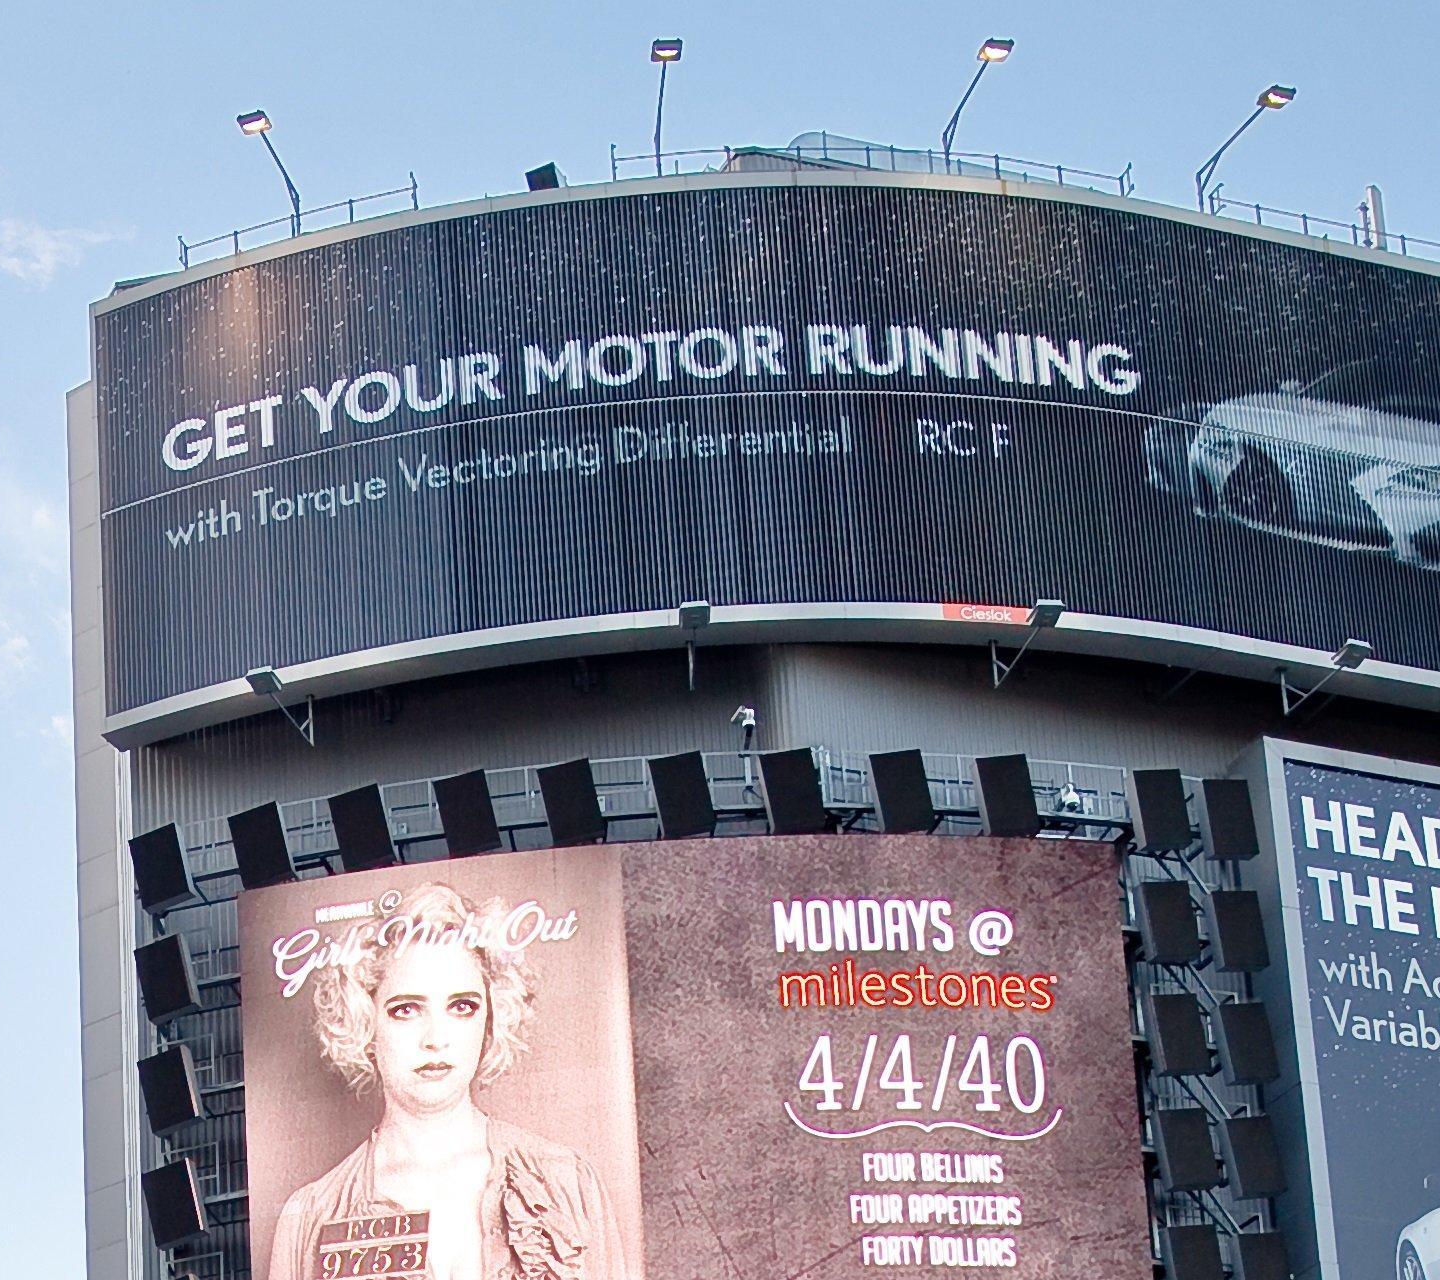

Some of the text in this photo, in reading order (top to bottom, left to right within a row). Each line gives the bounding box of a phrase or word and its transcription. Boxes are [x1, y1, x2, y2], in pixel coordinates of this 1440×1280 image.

[161, 324, 1140, 472] GET YOUR MOTOR RUNNING
[164, 506, 242, 549] with
[252, 474, 388, 528] Torque
[397, 431, 601, 493] Vectoring
[614, 417, 852, 464] Differential
[960, 605, 1012, 622] Cieslok
[500, 900, 579, 952] Out
[1306, 867, 1419, 935] THE
[773, 899, 1013, 955] MONDAYS @
[780, 960, 1054, 1009] milestones
[1319, 951, 1392, 992] with
[799, 1034, 1045, 1113] 4/4/40
[862, 1153, 1003, 1183] FOUR BELLINIS
[850, 1195, 1021, 1225] FOUR APPETIZERS
[862, 1236, 1016, 1267] FORTY DOLLARS
